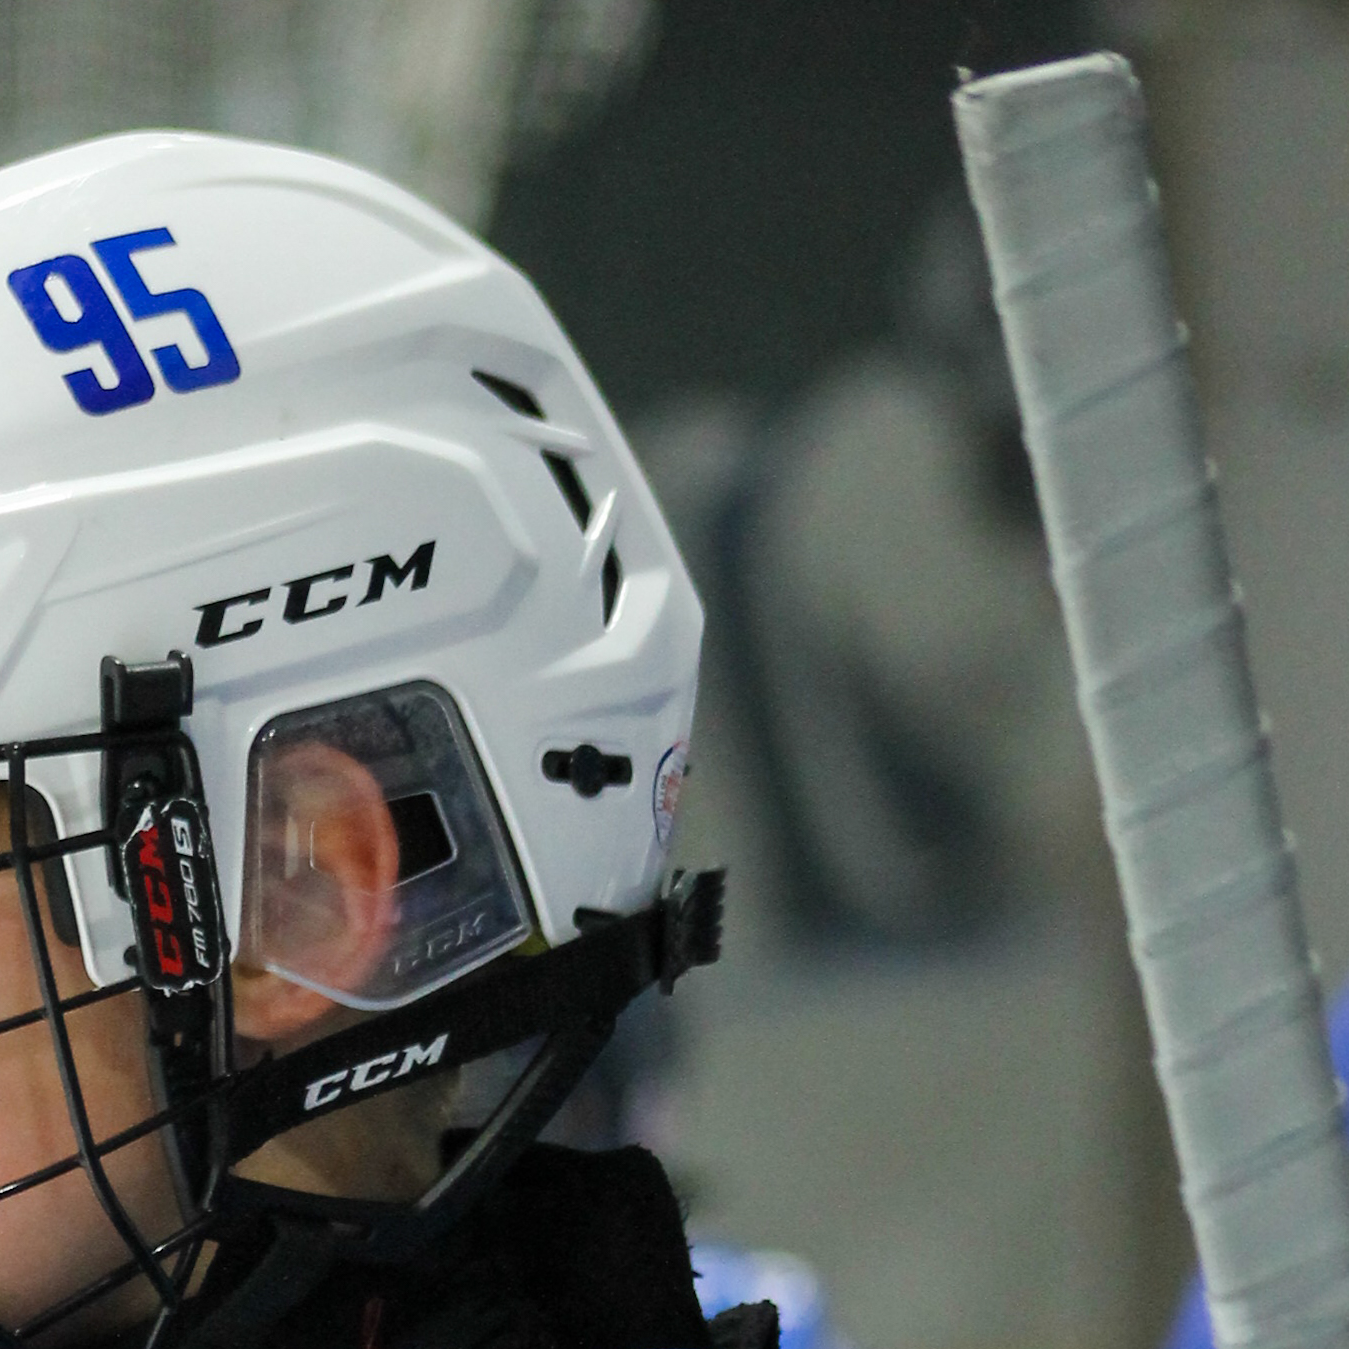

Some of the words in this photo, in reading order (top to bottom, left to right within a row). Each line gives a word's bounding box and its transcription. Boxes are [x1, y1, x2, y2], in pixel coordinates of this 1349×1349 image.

[8, 227, 242, 417] 95
[194, 540, 436, 649] CCM
[138, 826, 184, 978] CCM
[191, 928, 210, 969] FM
[303, 1033, 449, 1111] CCM
